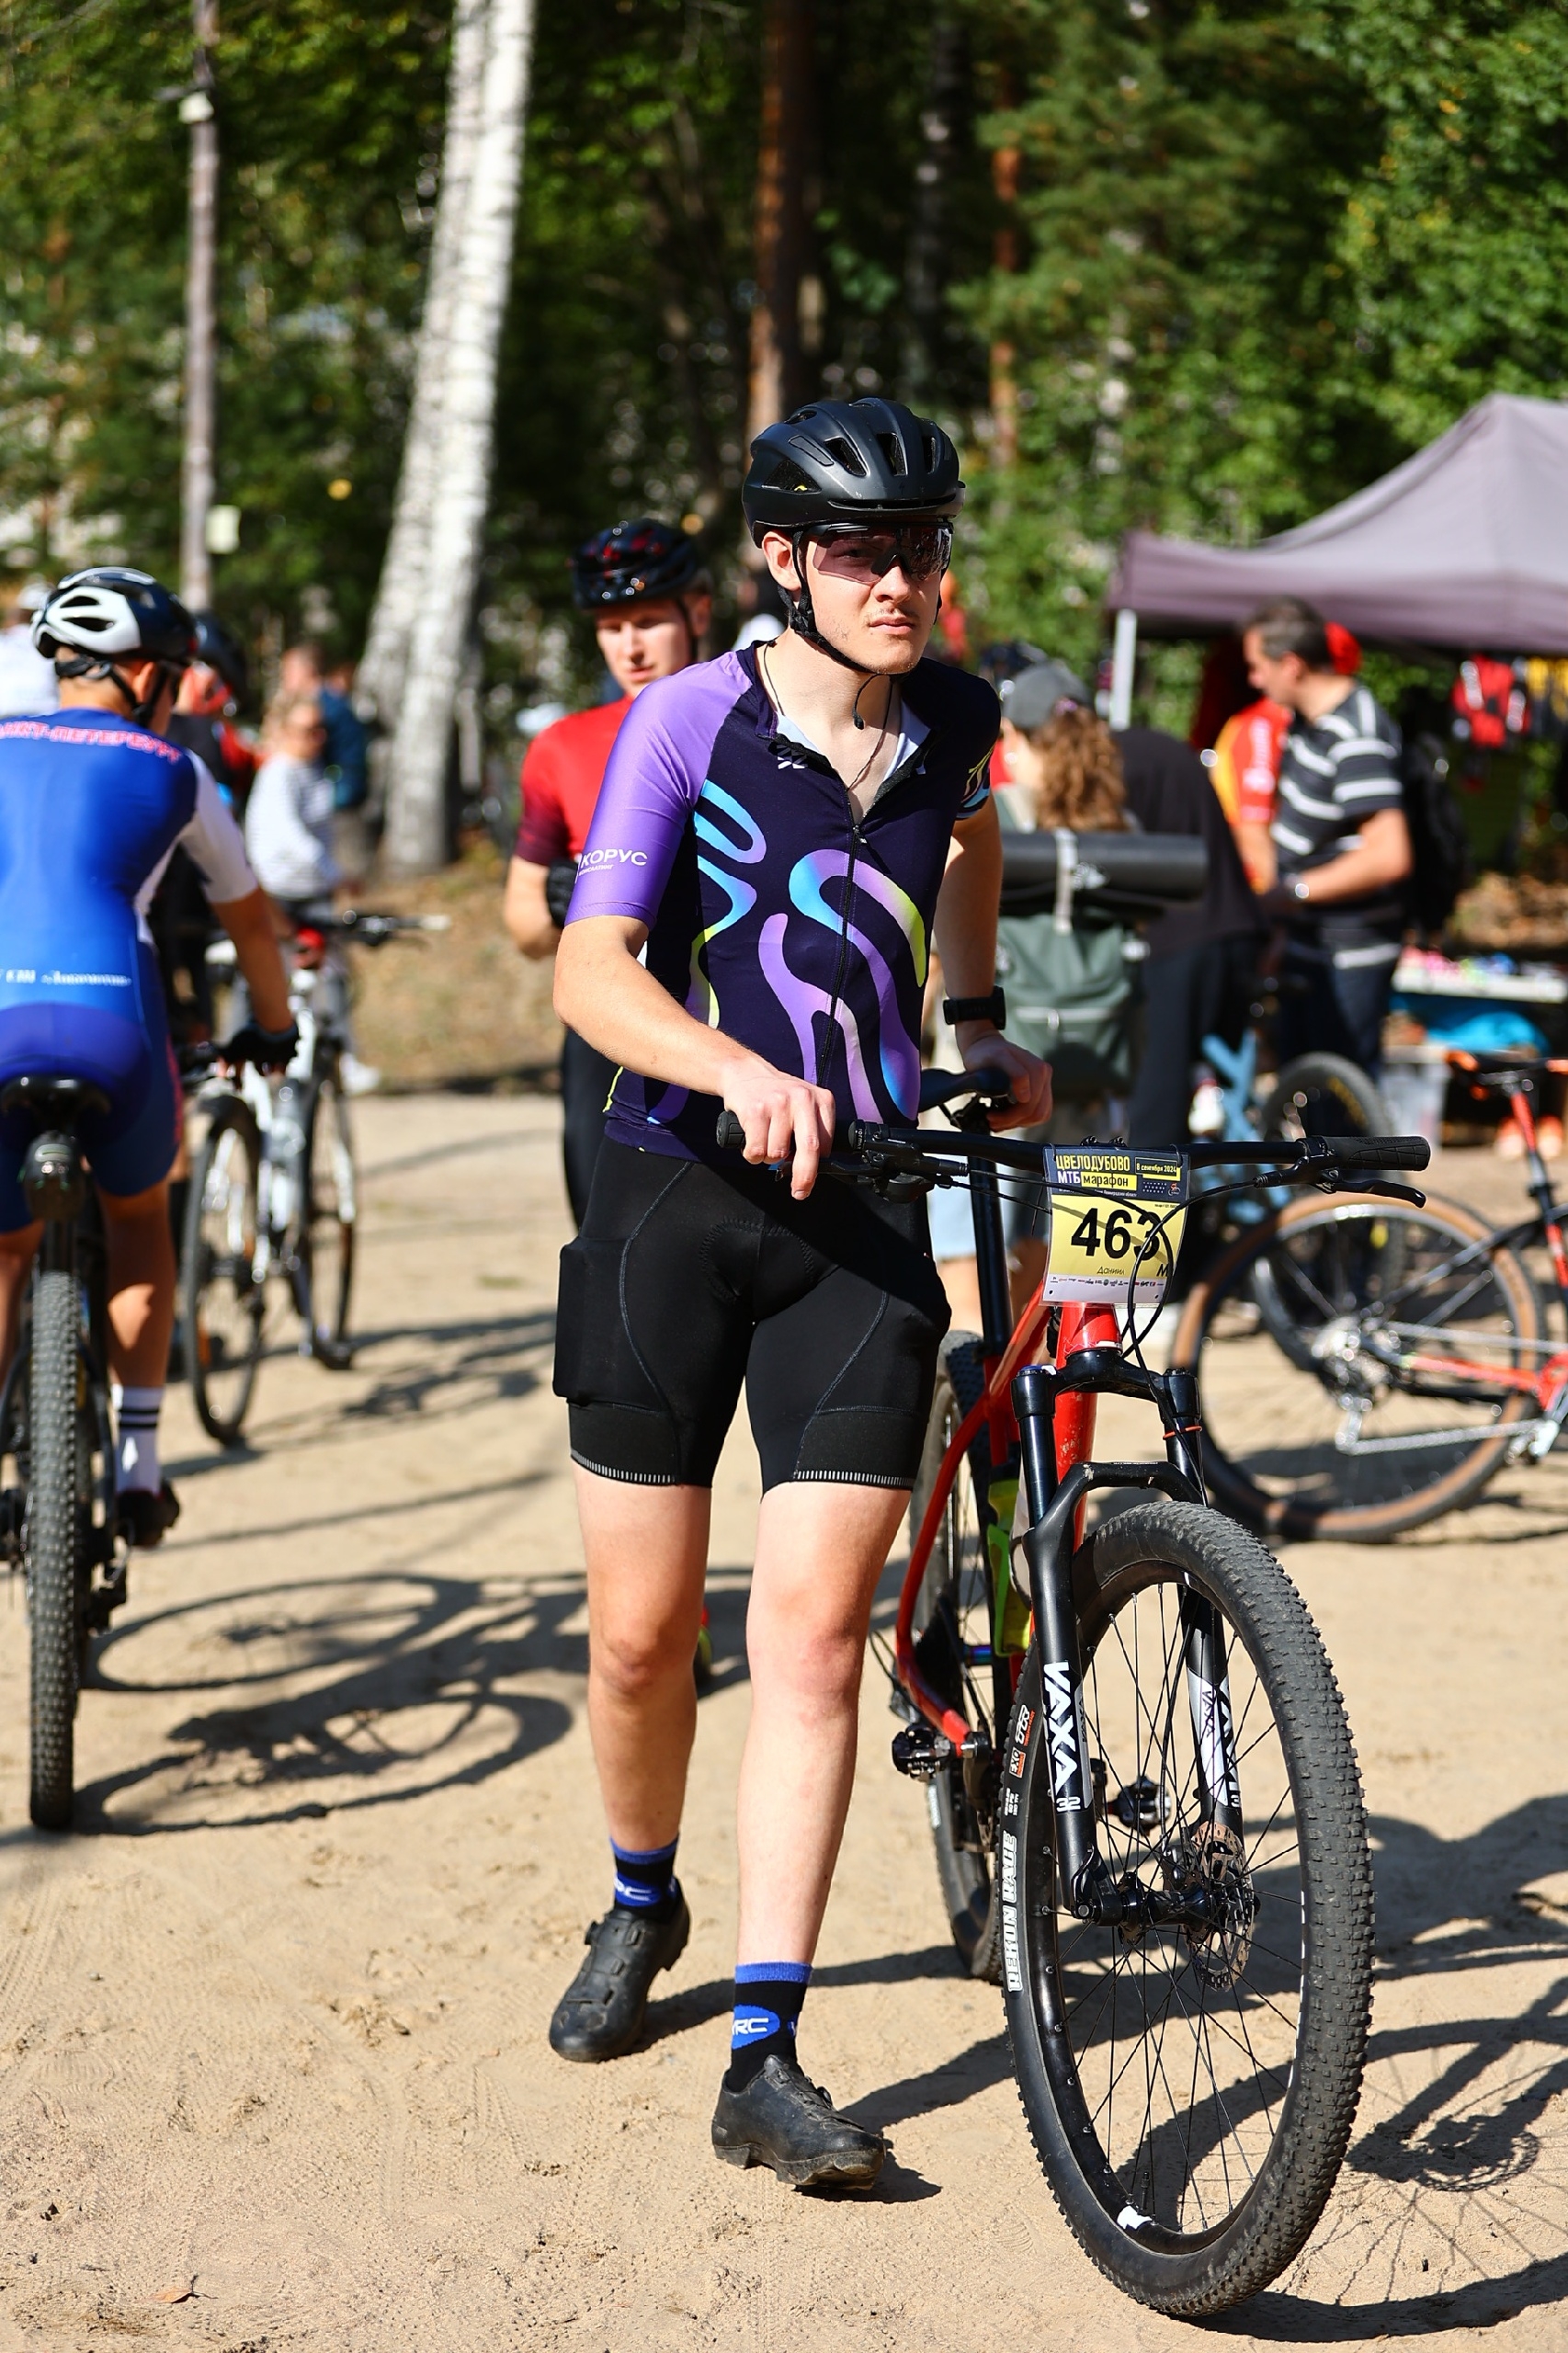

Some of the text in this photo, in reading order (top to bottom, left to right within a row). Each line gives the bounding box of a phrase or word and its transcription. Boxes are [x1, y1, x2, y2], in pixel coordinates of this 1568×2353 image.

[580, 848, 648, 869] КОРУС
[1056, 1154, 1131, 1172] ЦВЕЛОДУБОВО
[1136, 1163, 1177, 1174] 8 сентября 2024
[1058, 1170, 1129, 1188] МТБ марафон
[1071, 1207, 1162, 1261] 463
[1043, 1661, 1078, 1795] VAXA
[1056, 1796, 1081, 1812] 32
[1002, 1830, 1017, 1903] RACE
[1003, 1904, 1023, 1992] REKON
